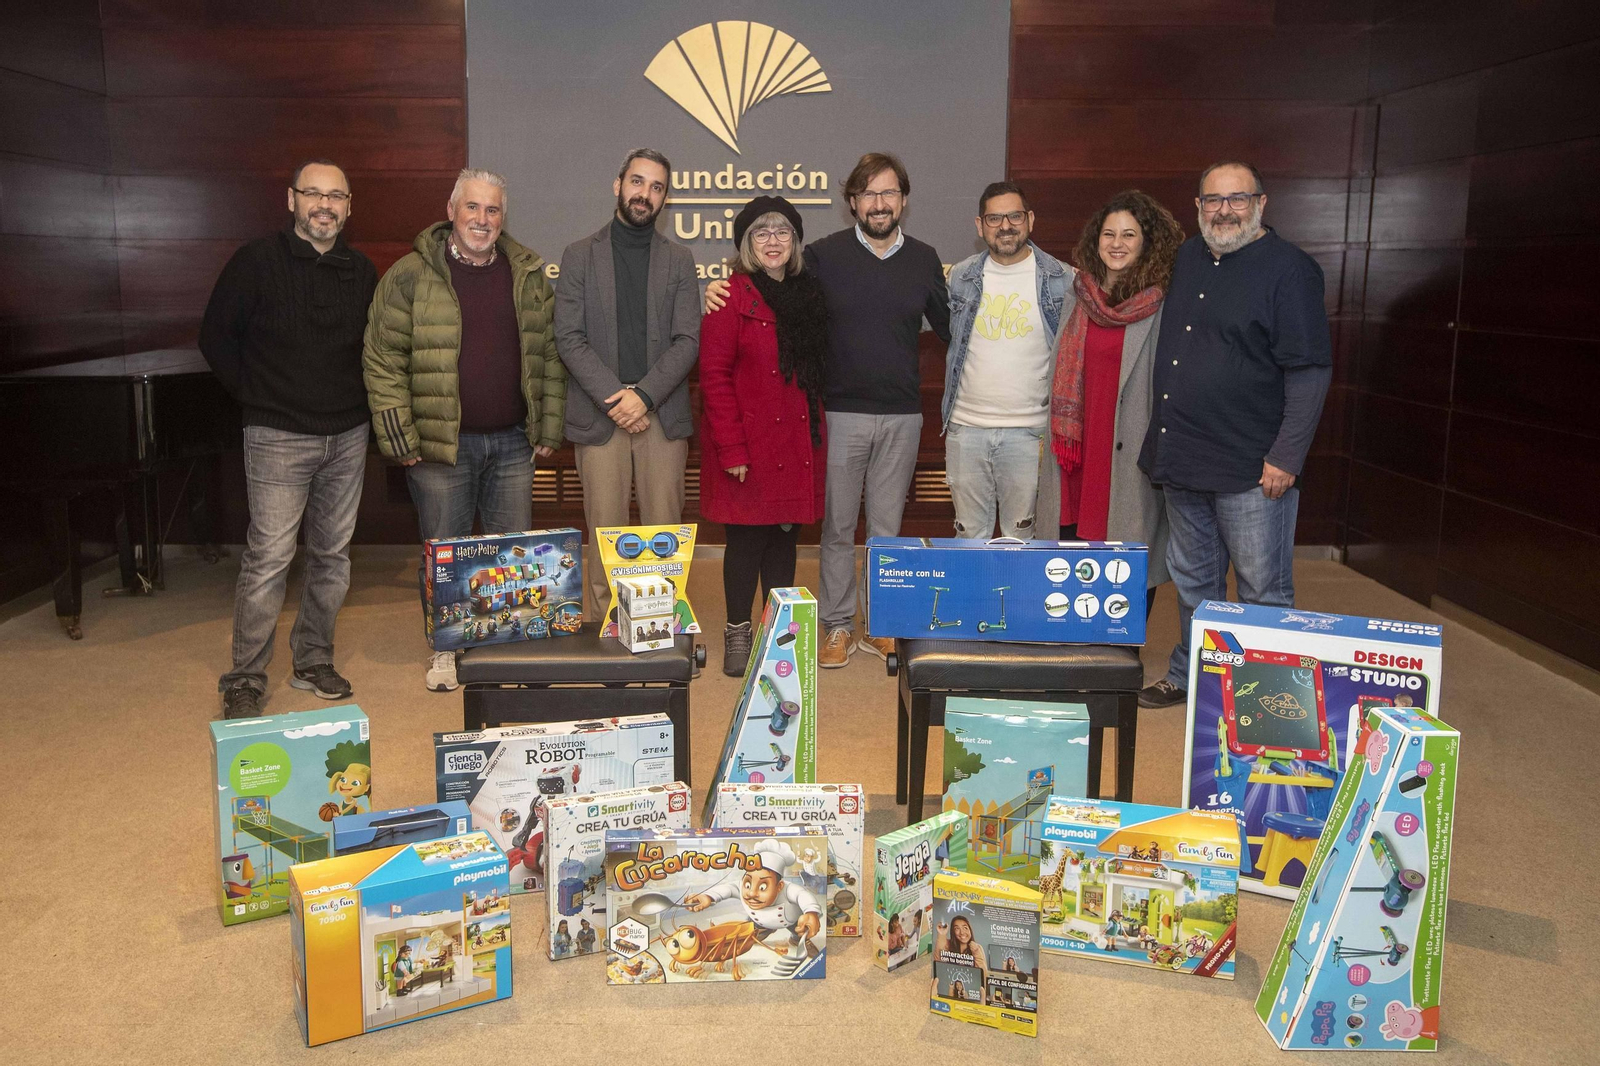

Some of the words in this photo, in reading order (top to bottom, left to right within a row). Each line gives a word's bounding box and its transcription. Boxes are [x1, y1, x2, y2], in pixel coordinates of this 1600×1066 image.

[670, 163, 828, 191] undación
[437, 550, 452, 559] LEGO
[456, 546, 477, 559] Harry
[477, 543, 500, 556] Potter
[879, 568, 914, 577] Patinete
[915, 570, 930, 578] con
[932, 569, 946, 578] luz
[1367, 619, 1439, 632] DESIGN
[1367, 624, 1440, 636] STUDIO
[1201, 650, 1245, 667] MOLTO
[1353, 650, 1423, 671] DESIGN
[780, 661, 788, 676] LED
[1349, 667, 1422, 690] STUDIO
[659, 731, 670, 740] 8+
[955, 735, 976, 744] Basket
[977, 737, 992, 745] Zone
[539, 740, 586, 751] EVOLUTION
[642, 746, 669, 755] STEM
[448, 752, 483, 764] ciencia
[485, 746, 507, 778] ROBOTICS
[525, 747, 586, 765] ROBOT
[240, 766, 263, 775] Basket
[768, 796, 825, 808] Smartivity
[1050, 796, 1100, 805] playmobil
[1207, 791, 1233, 806] 16
[601, 799, 656, 815] Smartivity
[576, 820, 610, 834] CREA
[613, 817, 630, 828] TU
[633, 810, 667, 825] GRÚA
[742, 811, 777, 821] CREA
[781, 811, 797, 821] TU
[801, 810, 837, 821] GRÚA
[1402, 815, 1412, 834] LED
[1441, 822, 1449, 834] flex
[1044, 826, 1097, 839] playmobil
[636, 843, 664, 863] La
[1178, 843, 1213, 861] Family
[1215, 847, 1234, 860] Fun
[1440, 836, 1448, 860] Patinete
[614, 843, 763, 891] Cucaracha
[895, 839, 931, 881] Jenga
[453, 864, 507, 886] playmobil
[897, 865, 930, 892] MAKER
[937, 887, 982, 901] PICTIONARY
[1422, 970, 1431, 1004] Trottinette
[1430, 877, 1438, 903] lumineux
[1436, 777, 1446, 800] flashing
[310, 900, 339, 913] Family
[339, 896, 354, 907] Fun
[947, 898, 975, 914] AIR
[319, 913, 346, 925] 70900
[990, 924, 1024, 934] ¡Conéctate
[1041, 937, 1064, 947] 70900
[1069, 942, 1085, 950] 4-10
[940, 950, 974, 960] ¡Interactúa
[1204, 938, 1233, 971] PROMO-PACK
[798, 953, 824, 978] Ravensburger
[1007, 981, 1037, 991] CONFIGURAR!
[1315, 1003, 1332, 1017] Pig
[1312, 1017, 1332, 1044] Peppa
